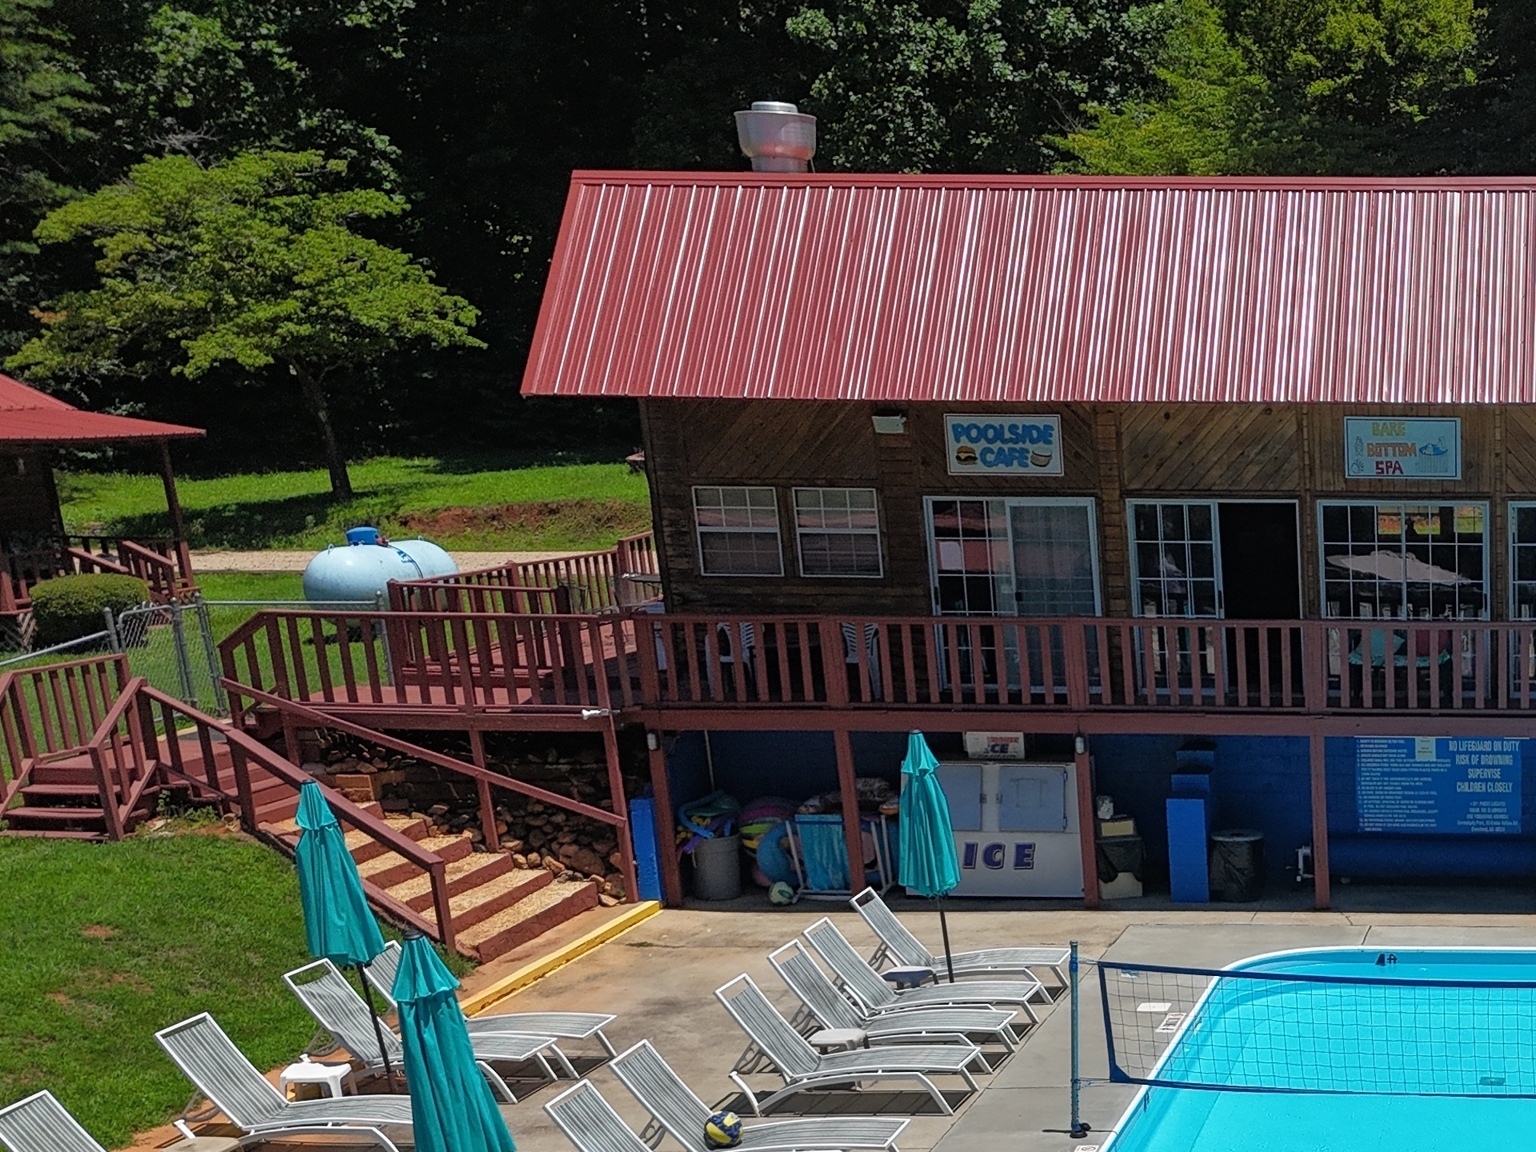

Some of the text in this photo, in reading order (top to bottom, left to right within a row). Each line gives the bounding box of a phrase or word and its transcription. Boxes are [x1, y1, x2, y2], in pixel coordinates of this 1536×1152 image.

[952, 423, 1054, 445] POOLSIDE
[1372, 422, 1406, 436] BARE
[1366, 443, 1417, 457] BOTTOM
[979, 447, 1030, 468] CAFE
[1375, 460, 1404, 475] SPA
[1459, 740, 1492, 752] LIFEGUARD
[1503, 740, 1520, 752] DUTY
[1467, 768, 1501, 779] SUPERVISE
[1456, 781, 1513, 793] CHILDREN CLOSELY
[962, 842, 1036, 870] ICE
